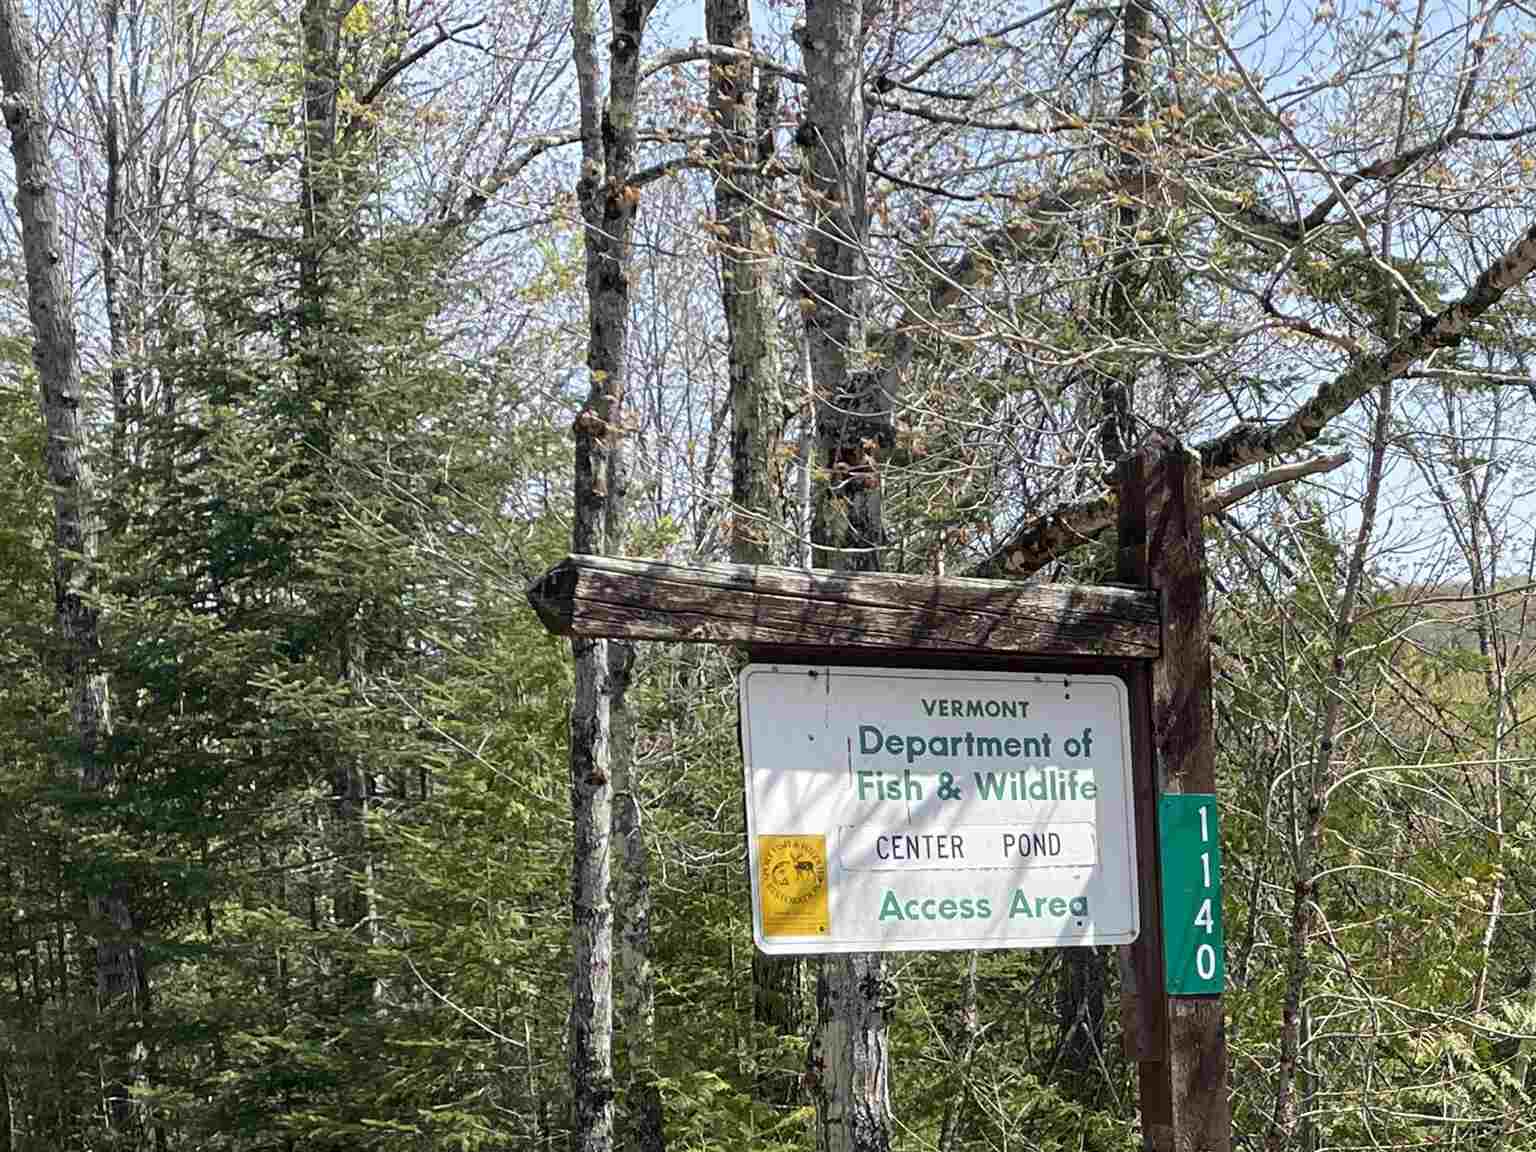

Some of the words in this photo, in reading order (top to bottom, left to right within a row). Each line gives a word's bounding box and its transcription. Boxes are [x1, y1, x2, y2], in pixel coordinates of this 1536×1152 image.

[921, 698, 1030, 719] VERMONT
[858, 725, 1051, 764] Department
[1063, 727, 1093, 758] of
[857, 769, 923, 800] Fish
[936, 771, 962, 800] &
[974, 768, 1097, 801] Wildlife
[876, 835, 965, 860] CENTER
[1003, 832, 1062, 857] POND
[879, 890, 993, 920] Access
[1008, 888, 1088, 919] Area
[1194, 806, 1216, 980] 1140
